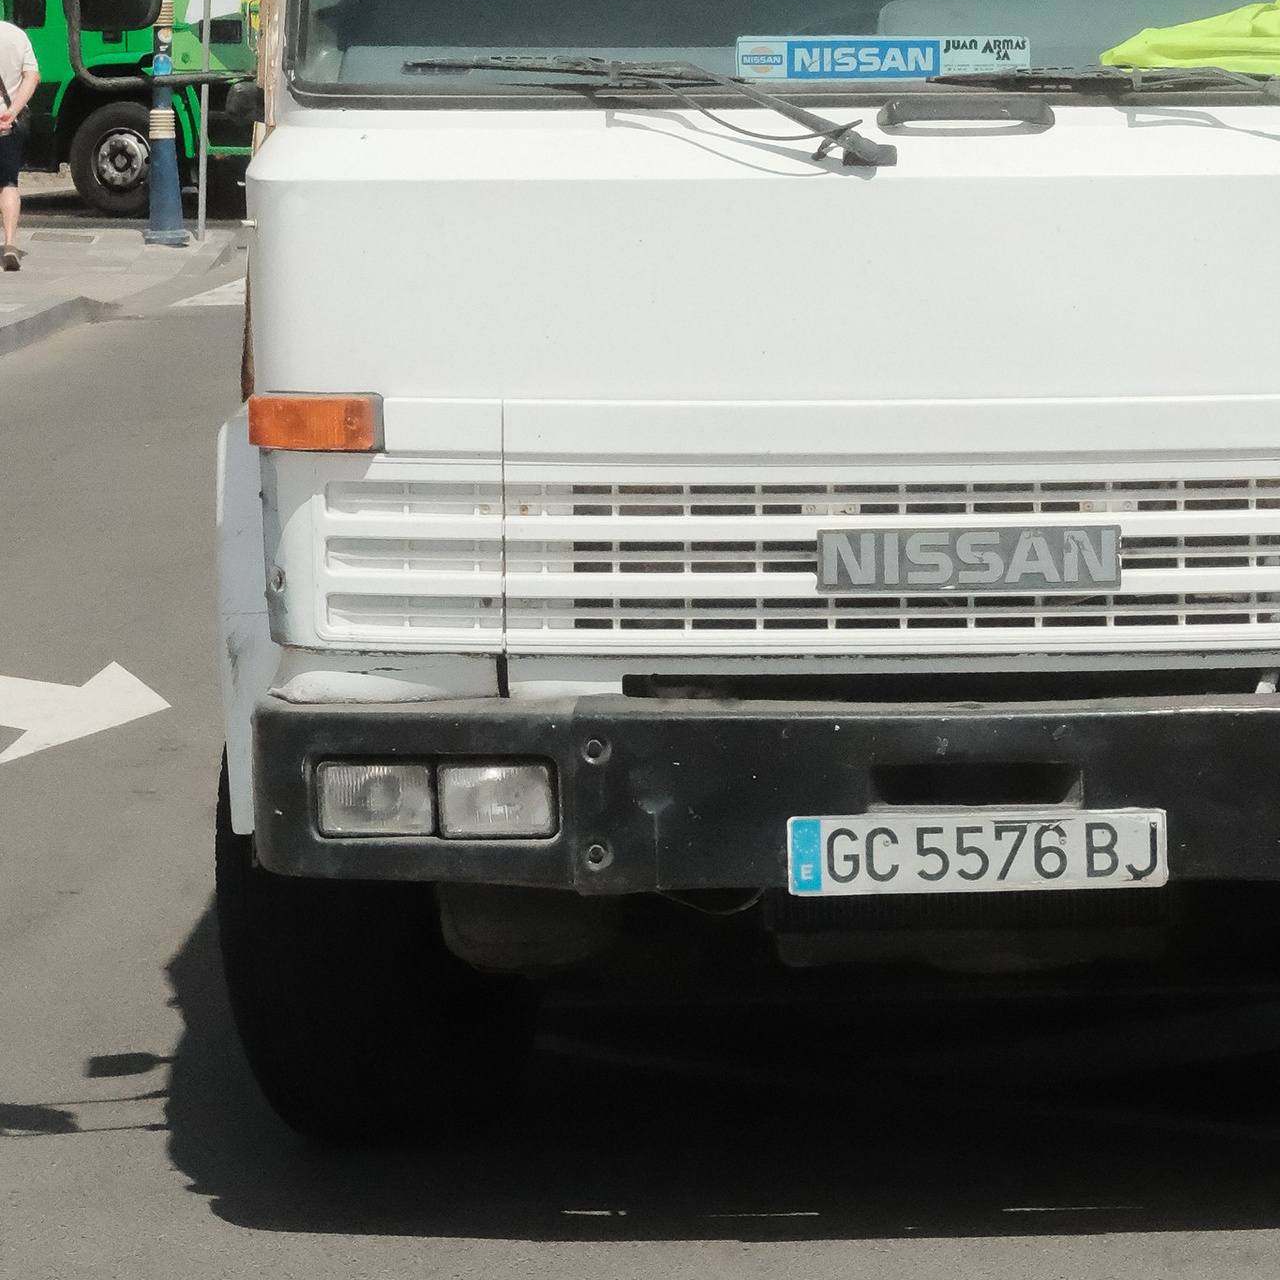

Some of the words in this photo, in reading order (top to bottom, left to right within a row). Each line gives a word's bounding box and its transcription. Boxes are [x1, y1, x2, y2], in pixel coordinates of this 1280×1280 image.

[743, 56, 781, 64] NISSAN
[794, 47, 934, 72] NISSAN
[821, 530, 1117, 586] NISSAN
[826, 826, 900, 883] GC
[916, 822, 1067, 882] 5576
[1085, 821, 1158, 881] BJ
